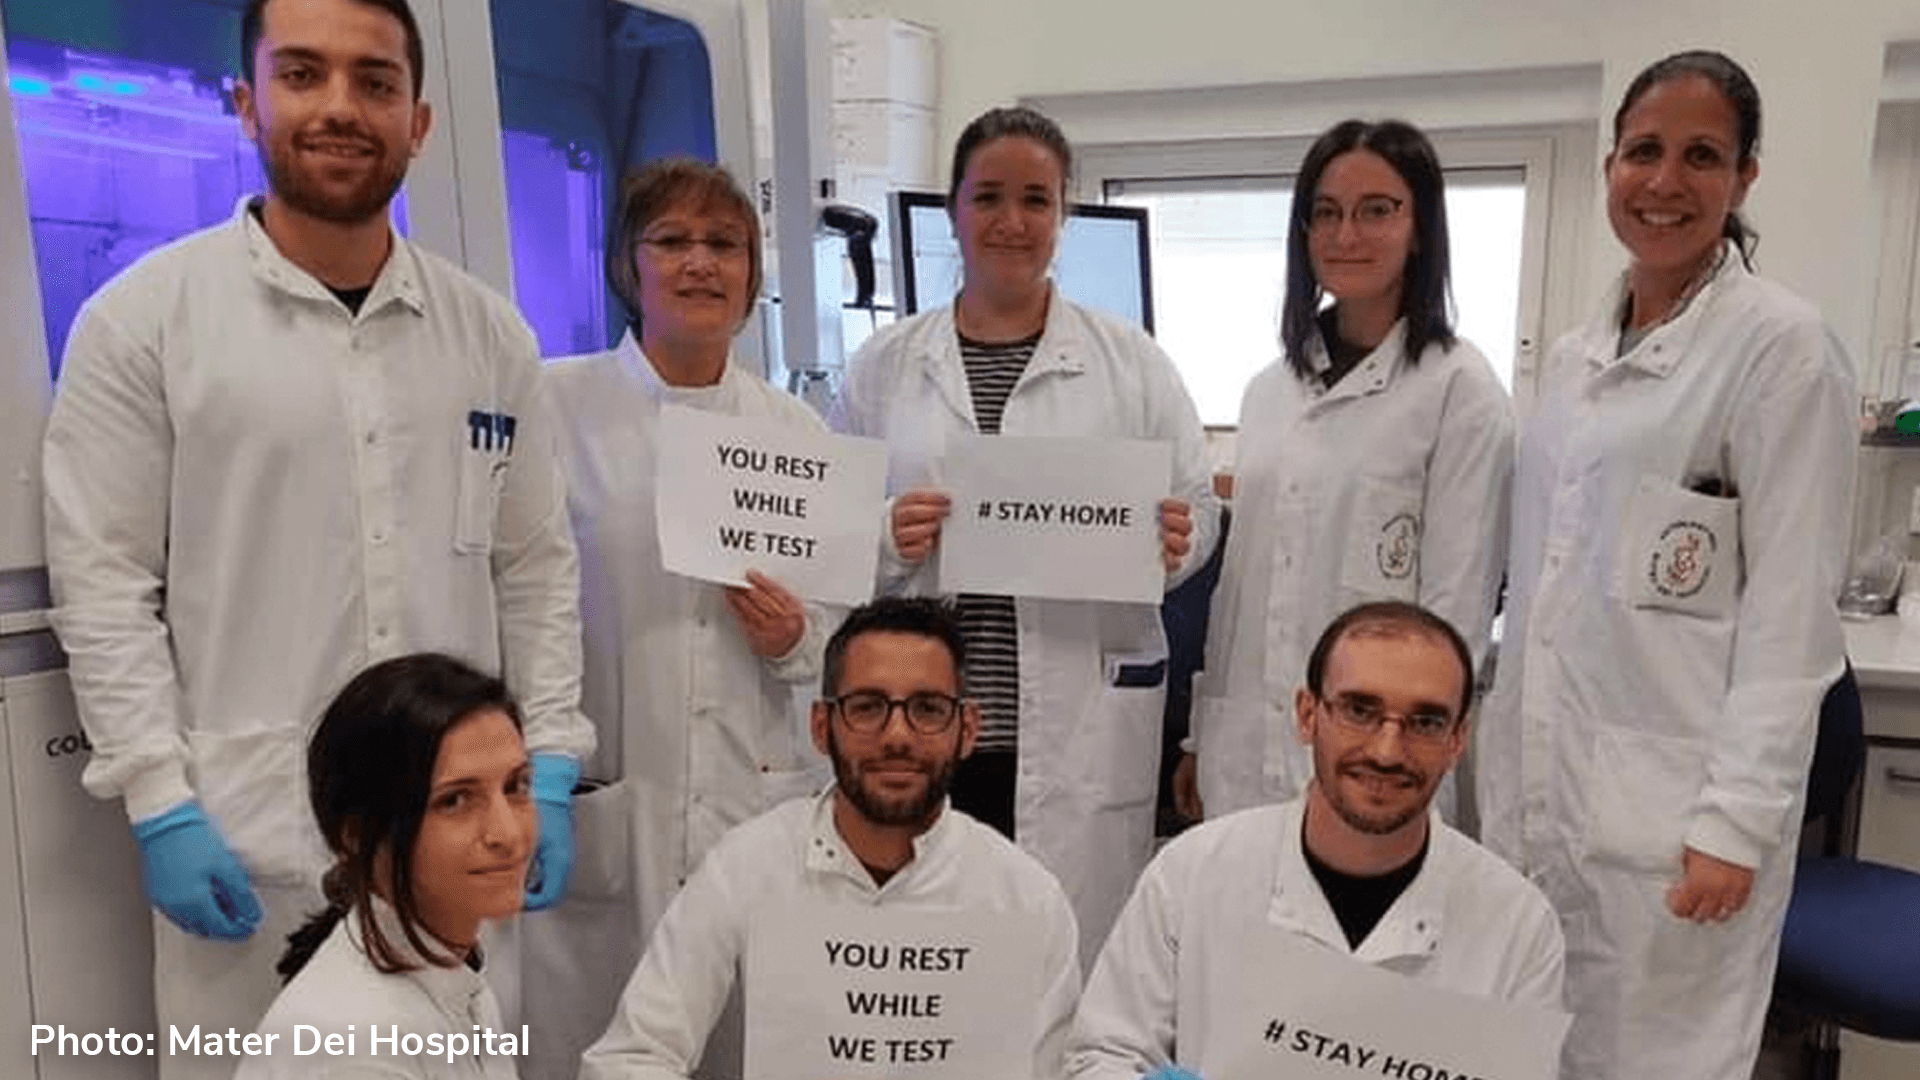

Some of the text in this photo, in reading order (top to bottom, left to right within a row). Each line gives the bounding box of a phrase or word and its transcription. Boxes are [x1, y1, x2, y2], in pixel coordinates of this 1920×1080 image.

[718, 445, 829, 481] YOU REST
[733, 488, 807, 519] WHILE
[978, 502, 1133, 526] # STAY HOME
[720, 526, 817, 558] WE TEST
[825, 941, 971, 971] YOU REST
[846, 991, 942, 1018] WHILE
[828, 1036, 953, 1062] WE TEST
[1264, 1019, 1488, 1080] # STAY HO
